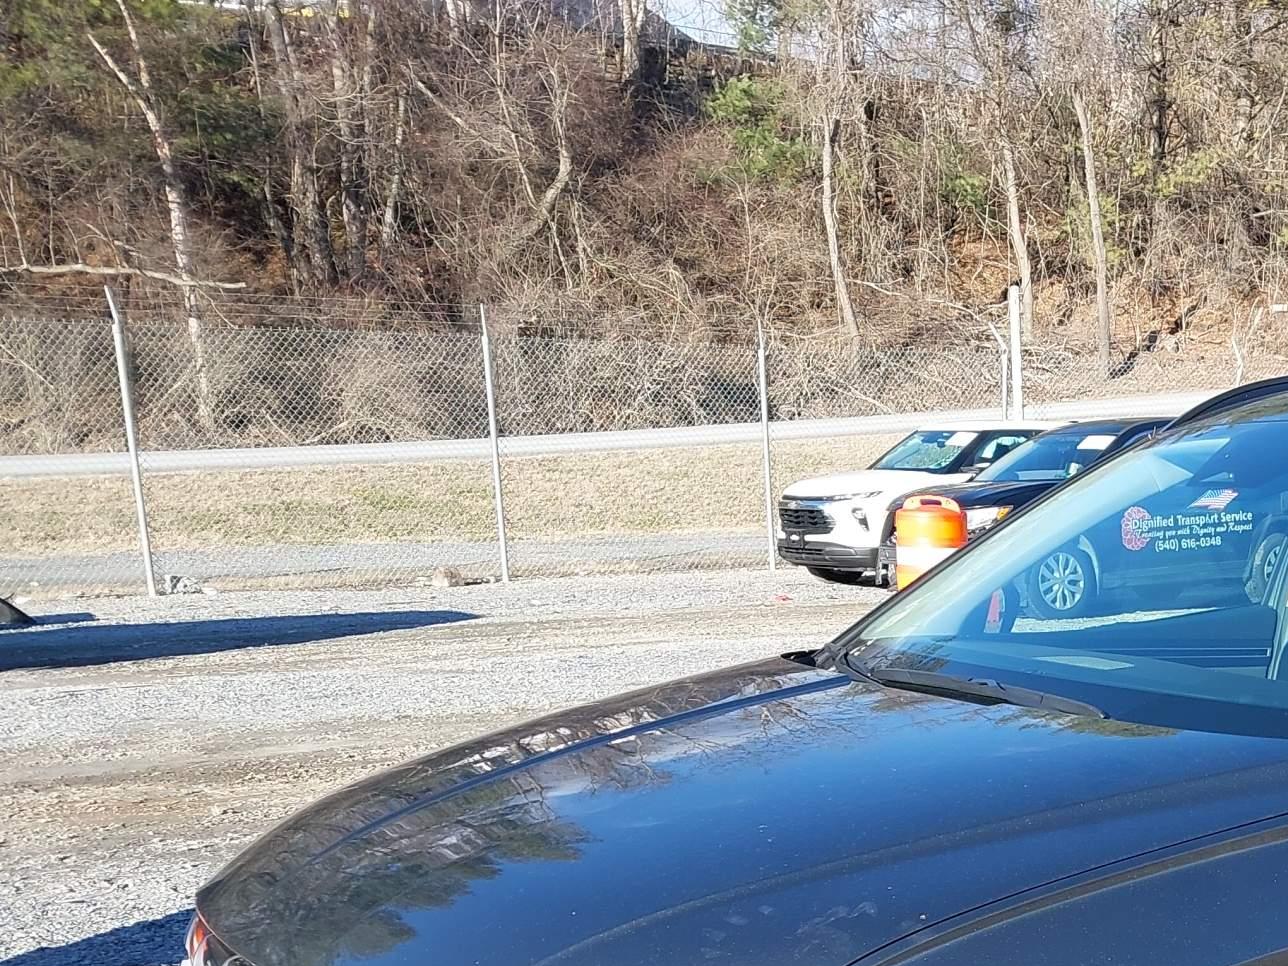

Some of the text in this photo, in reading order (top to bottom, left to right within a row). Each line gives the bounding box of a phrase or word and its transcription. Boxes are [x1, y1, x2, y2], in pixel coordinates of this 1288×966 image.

[1132, 510, 1253, 531] Dignified Transport Service
[1191, 525, 1215, 537] Dignity
[1227, 522, 1253, 534] Respect
[1154, 535, 1222, 552] (540) 616-0348
